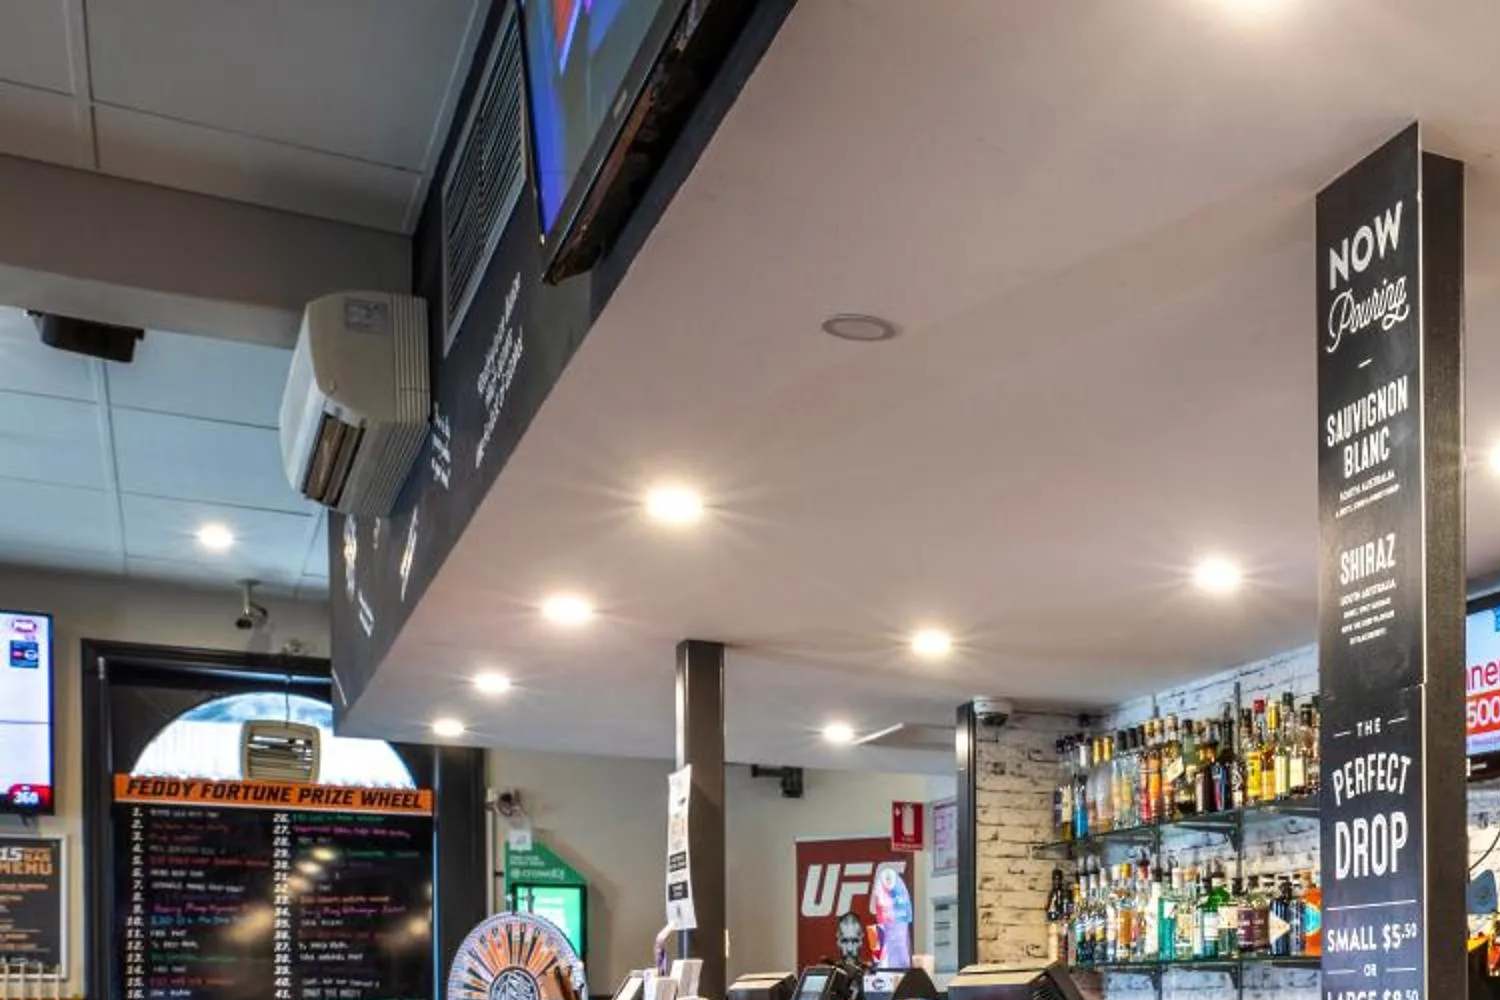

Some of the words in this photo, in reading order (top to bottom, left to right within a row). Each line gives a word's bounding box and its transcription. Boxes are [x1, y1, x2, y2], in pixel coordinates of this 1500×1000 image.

[1329, 200, 1403, 291] NOW
[1326, 275, 1410, 353] Pouring
[1326, 374, 1408, 448] SAUVIGNON
[1343, 425, 1390, 479] BLANC
[1340, 532, 1396, 586] SHIRAZ
[1356, 717, 1381, 738] THE
[127, 779, 194, 798] FEDDY
[200, 782, 292, 802] FORTUNE
[299, 788, 353, 805] PRIZE
[361, 791, 423, 809] WHEEL
[1332, 752, 1412, 807] PERFECT
[1335, 811, 1409, 880] DROP
[1326, 925, 1377, 953] SMALL
[1363, 963, 1377, 977] OR
